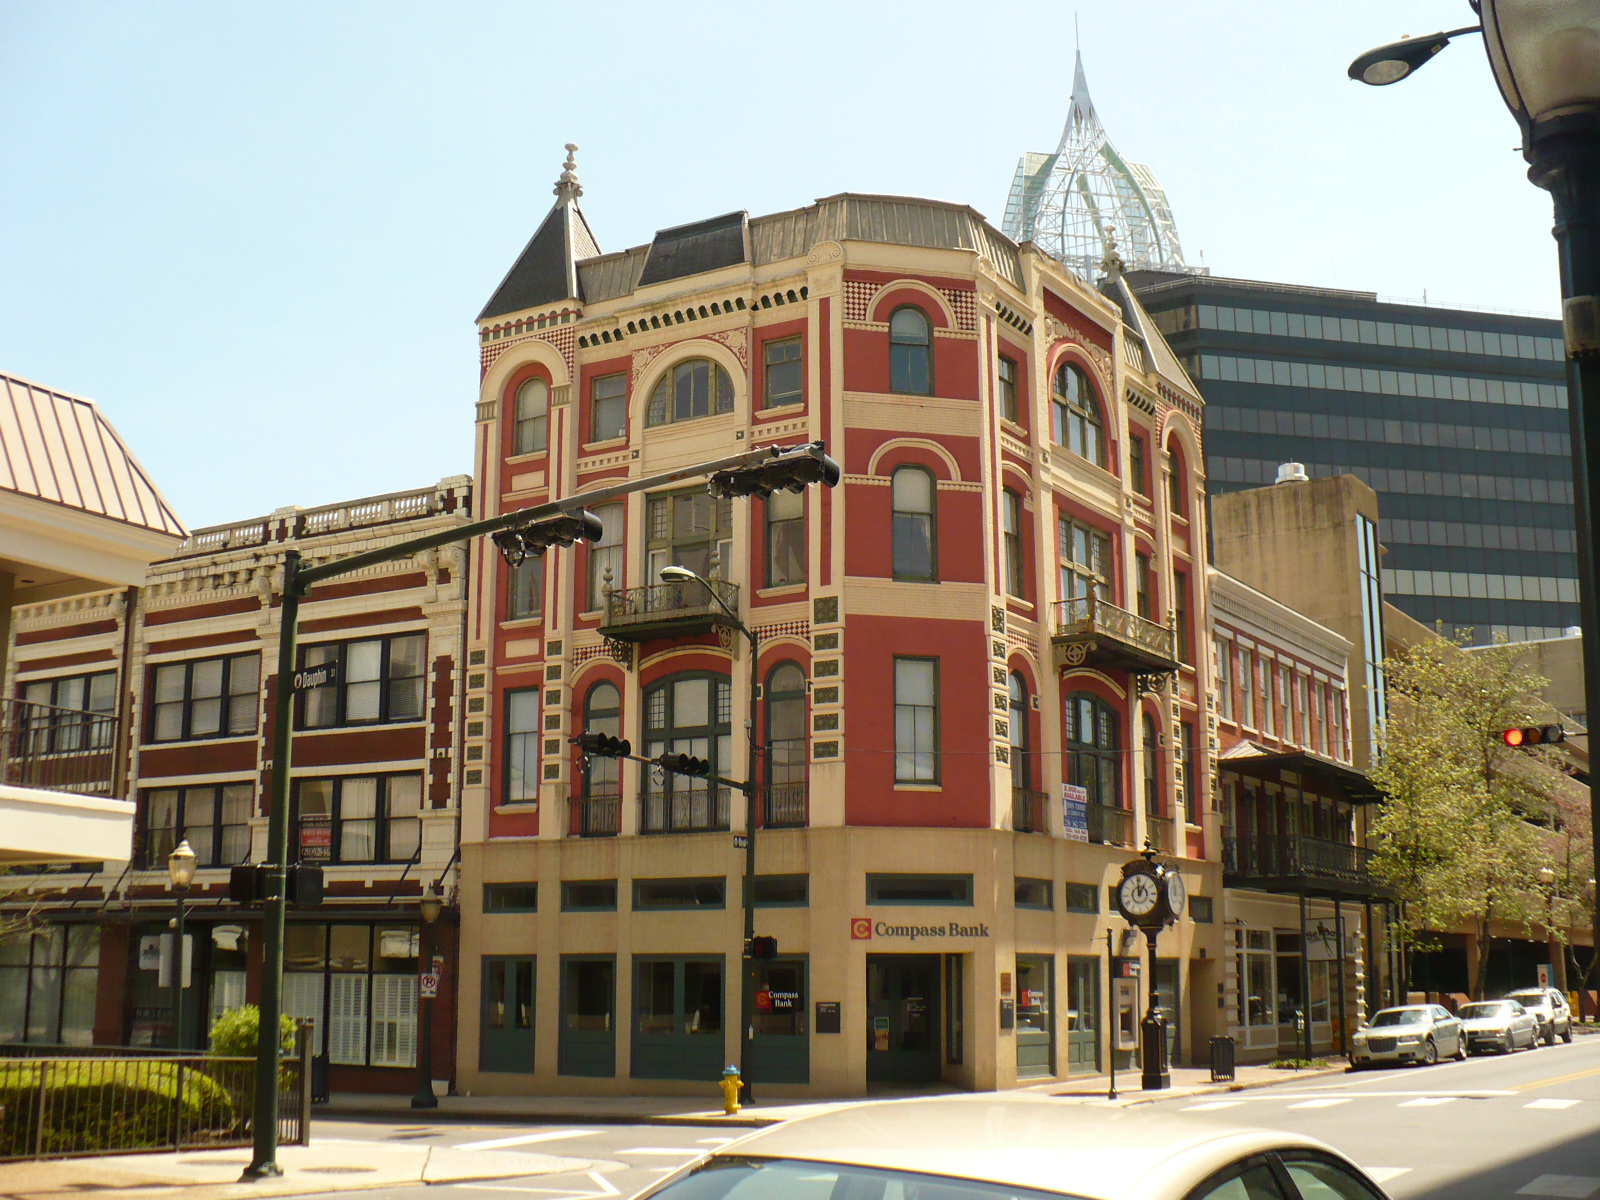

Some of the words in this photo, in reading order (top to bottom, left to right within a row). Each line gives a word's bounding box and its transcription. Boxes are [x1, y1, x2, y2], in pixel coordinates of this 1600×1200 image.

[303, 669, 327, 689] Dauphin
[875, 921, 947, 940] Compass
[948, 922, 990, 938] Bank
[768, 991, 799, 1000] Compass
[774, 999, 793, 1008] Bank
